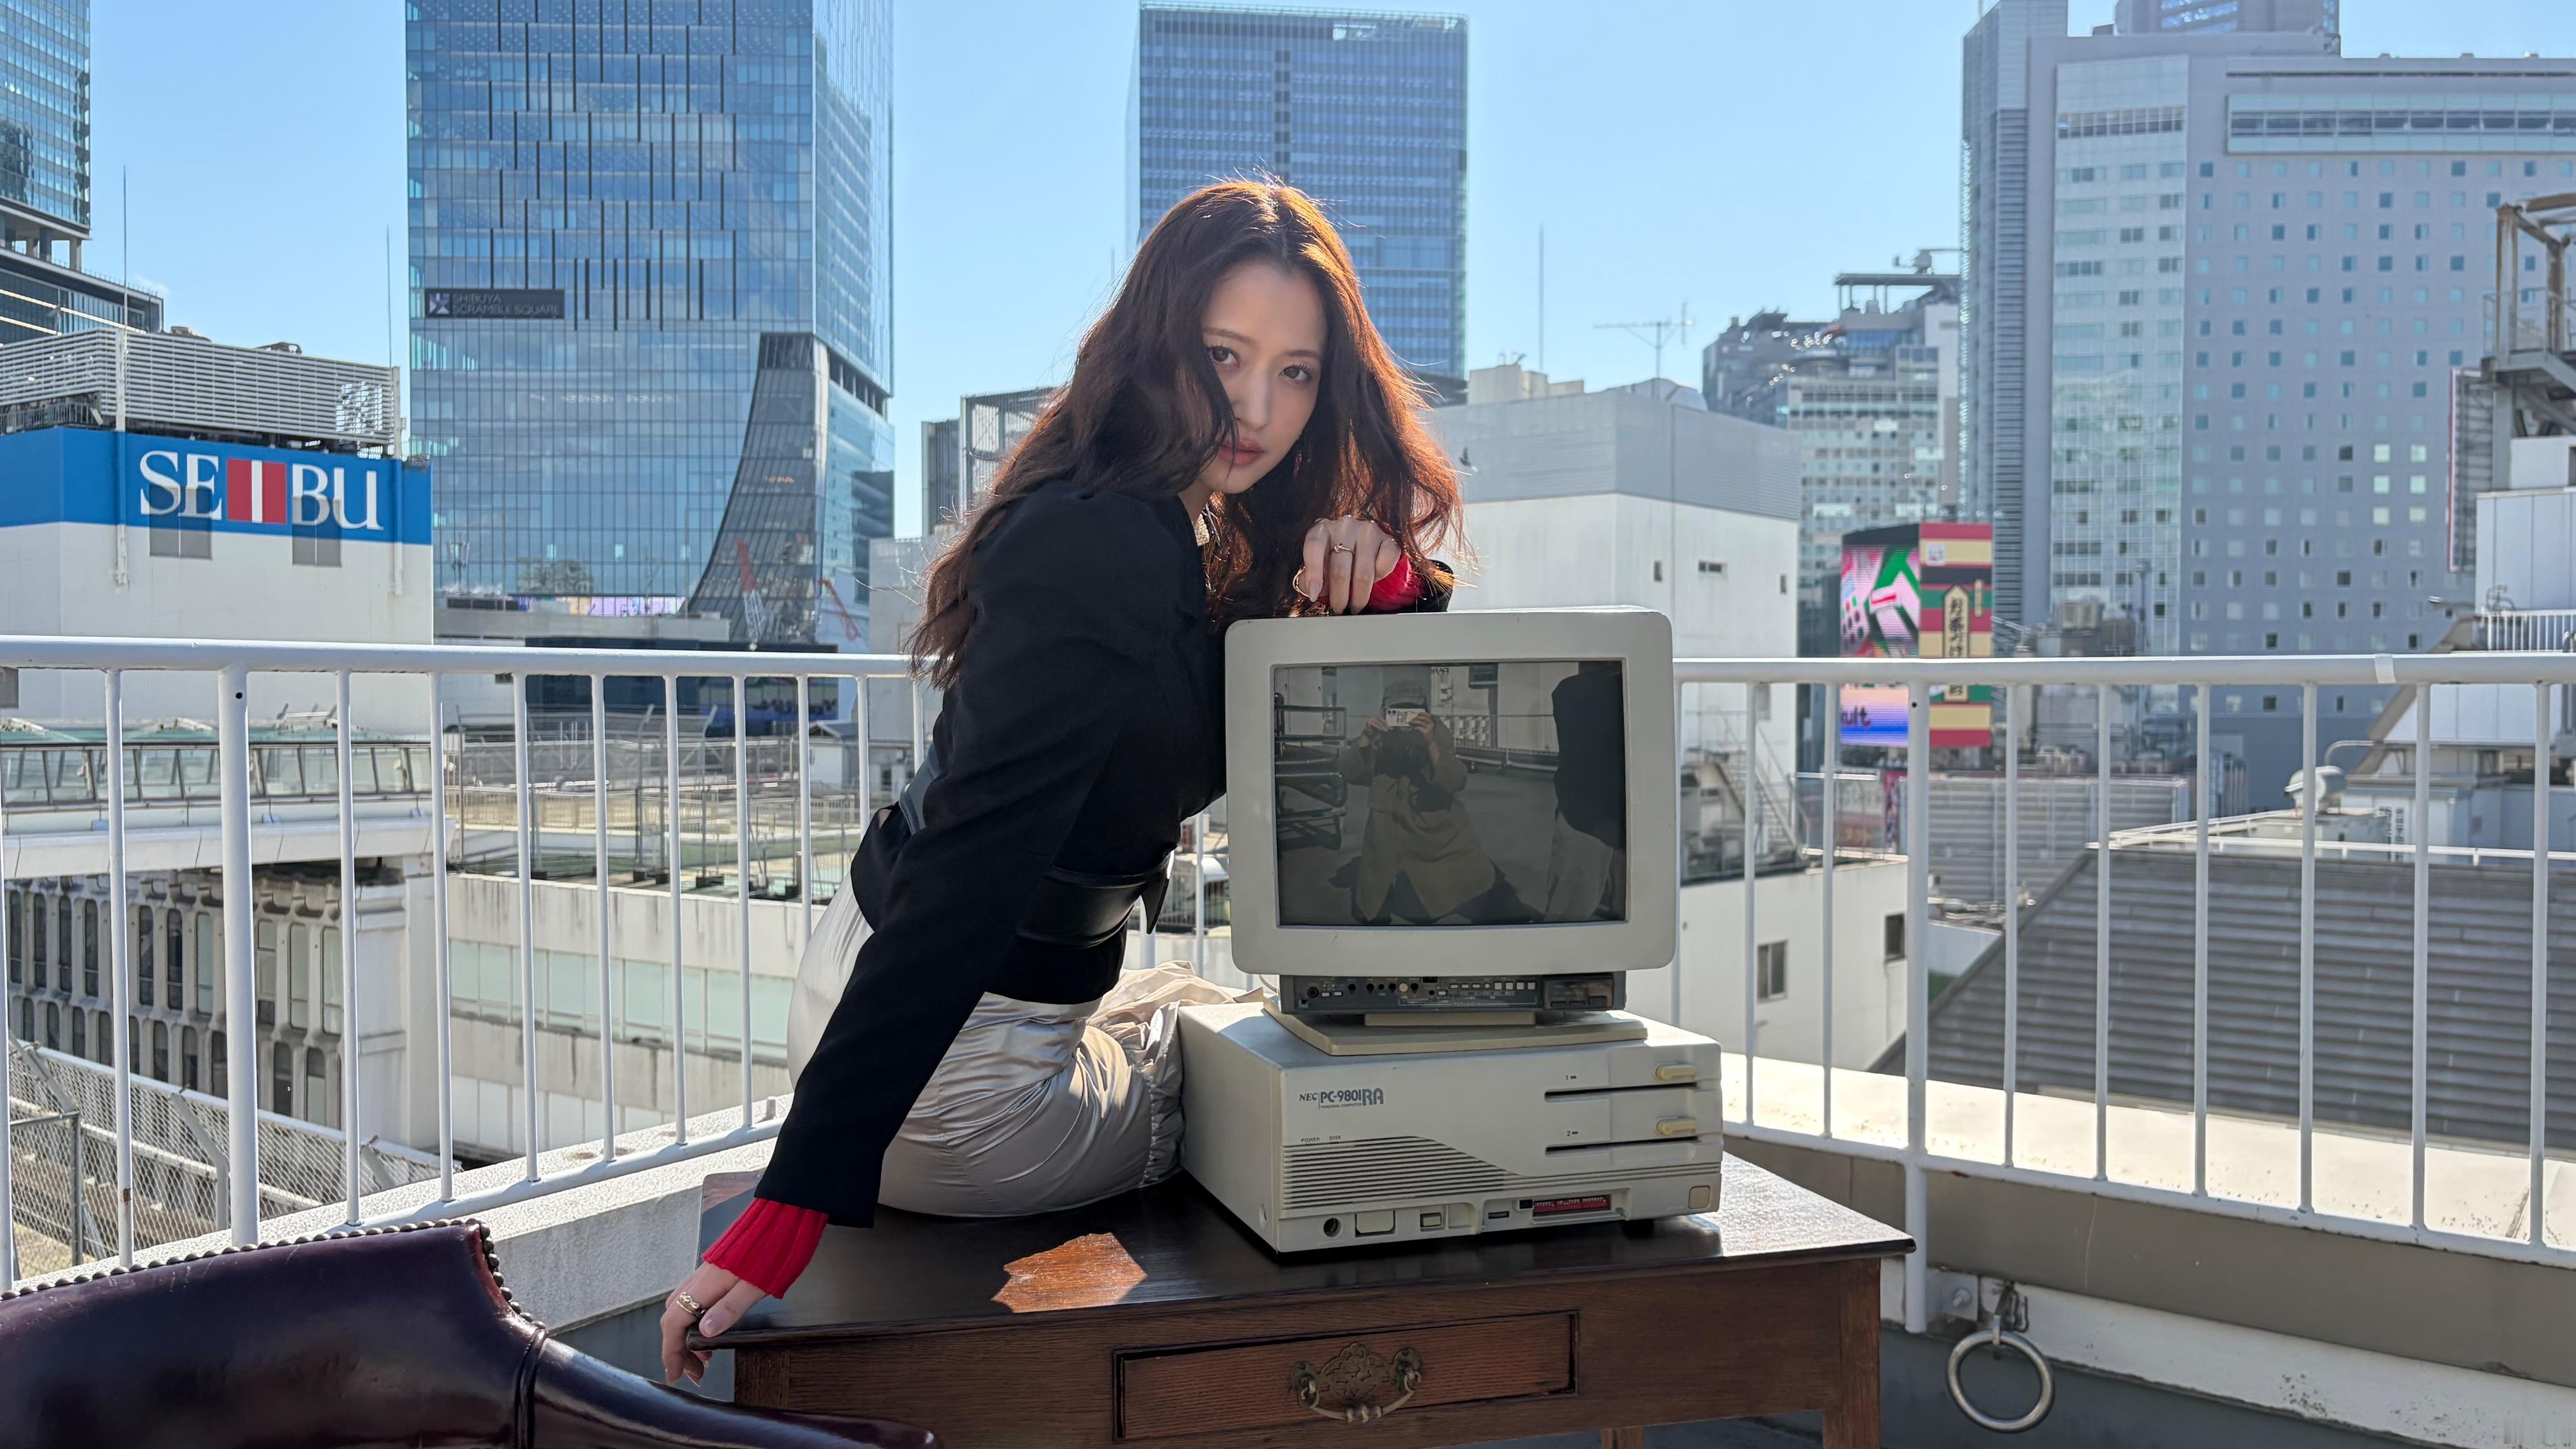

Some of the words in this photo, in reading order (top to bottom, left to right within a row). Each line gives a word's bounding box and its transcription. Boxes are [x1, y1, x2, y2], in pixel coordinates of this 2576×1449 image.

[452, 292, 502, 304] SHIBUYA
[453, 304, 511, 314] SCRAMBLE
[514, 304, 560, 314] SQUARE
[140, 450, 385, 531] SEIBU
[1299, 1092, 1318, 1101] NEC
